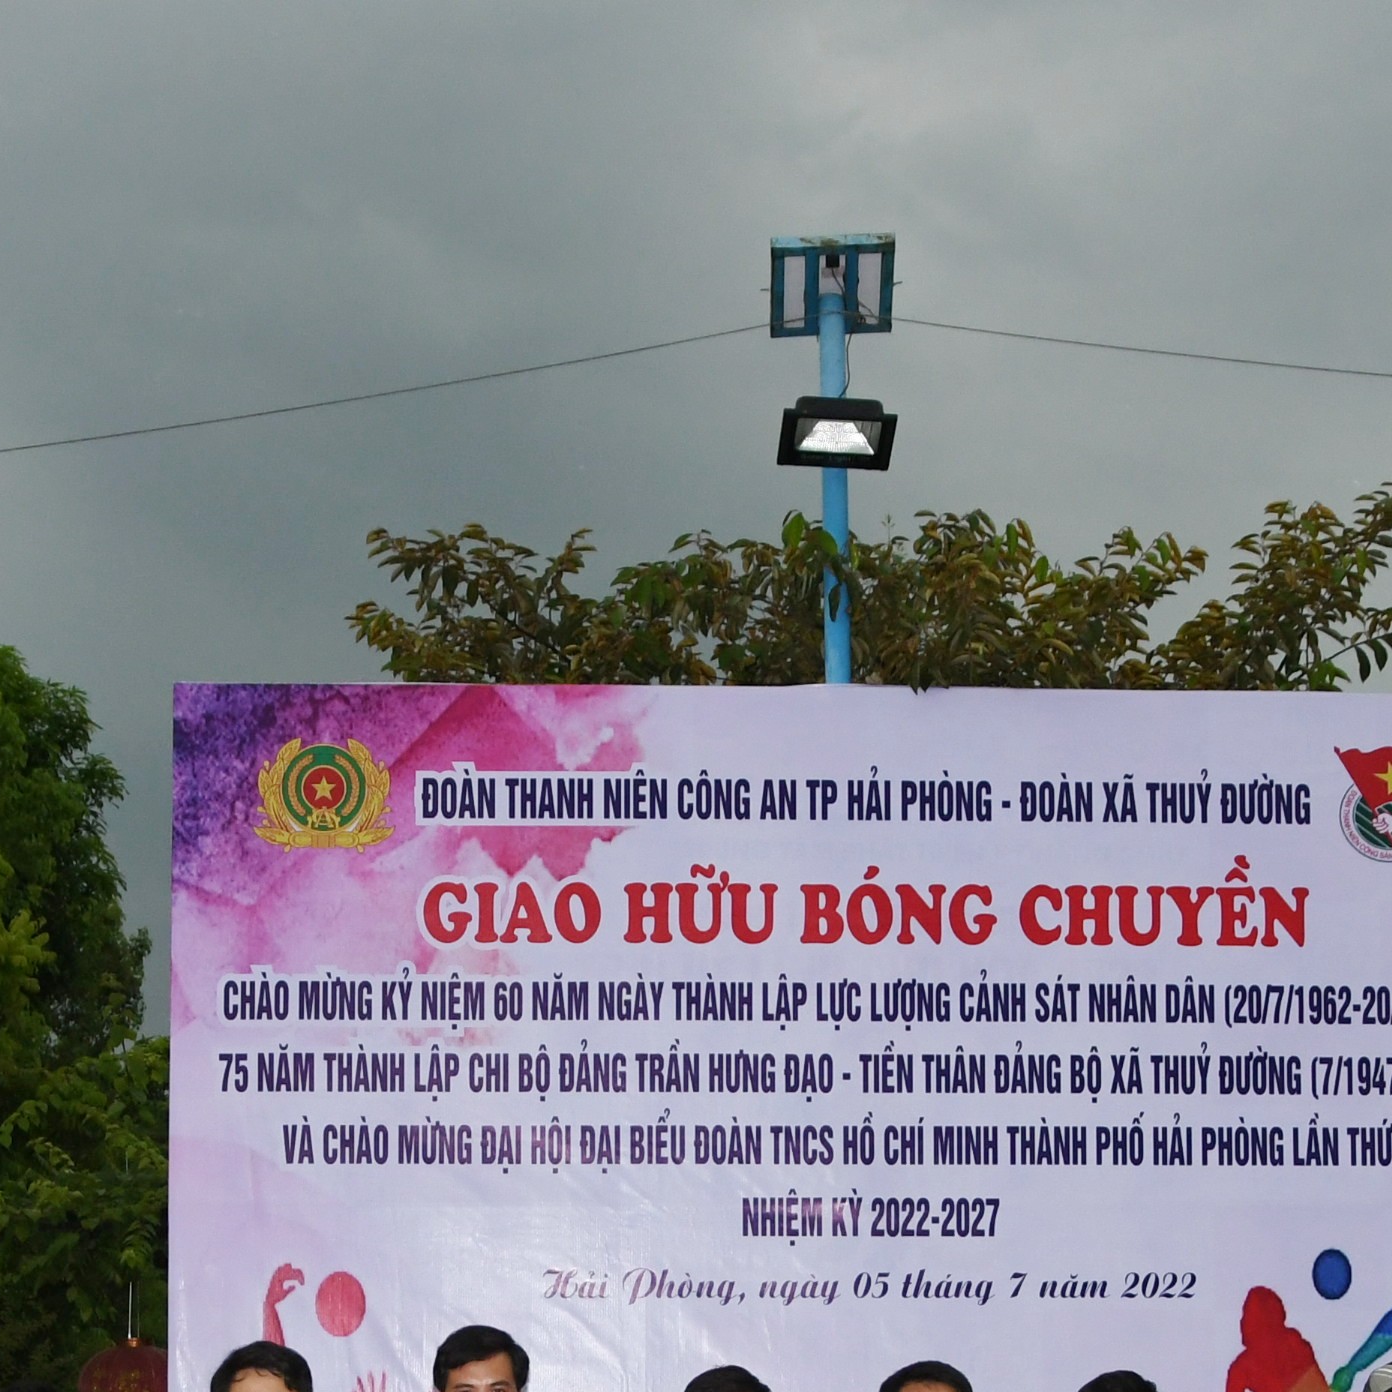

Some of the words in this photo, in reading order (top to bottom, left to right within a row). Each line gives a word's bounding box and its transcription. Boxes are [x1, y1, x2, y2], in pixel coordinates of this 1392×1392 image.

[422, 769, 495, 818] ĐOÀN
[506, 779, 593, 818] THANH
[604, 770, 667, 819] NIÊN
[678, 770, 750, 820] CÔNG
[760, 780, 796, 820] AN
[806, 780, 837, 820] TP
[848, 766, 890, 820] HẢI
[902, 771, 991, 821] PHÒNG
[1020, 773, 1092, 822] ĐOÀN
[1103, 774, 1137, 822] XÃ
[1146, 769, 1211, 823] THUỶ
[1221, 774, 1310, 824] ĐƯỜNG
[423, 882, 601, 944] GIAO
[624, 864, 778, 944] HỮU
[800, 865, 998, 945] BÓNG
[1019, 855, 1310, 947] CHUYỀN
[224, 972, 288, 1020] CHÀO
[299, 973, 372, 1020] MỪNG
[382, 968, 412, 1020] KỶ
[422, 973, 484, 1029] NIỆM
[495, 982, 522, 1020] 60
[533, 974, 588, 1020] NĂM
[599, 973, 663, 1020] NGÀY
[672, 974, 752, 1020] THÀNH
[763, 974, 807, 1030] LẬP
[817, 979, 860, 1030] LỰC
[871, 979, 950, 1031] LƯỢNG
[960, 969, 1025, 1022] CẢNH
[1036, 975, 1080, 1022] SÁT
[1089, 975, 1156, 1022] NHÂN
[1166, 976, 1214, 1023] DÂN
[219, 1054, 248, 1092] 75
[258, 1045, 314, 1091] NĂM
[324, 1045, 404, 1091] THÀNH
[415, 1045, 459, 1101] LẬP
[470, 1054, 508, 1092] CHI
[519, 1045, 549, 1101] BỘ
[559, 1040, 626, 1092] ĐẢNG
[636, 1045, 699, 1092] TRẦN
[710, 1050, 775, 1093] HƯNG
[785, 1054, 832, 1102] ĐẠO
[860, 1041, 913, 1093] TIỀN
[922, 1046, 985, 1093] THÂN
[994, 1041, 1061, 1093] ĐẢNG
[1071, 1047, 1101, 1103] BỘ
[1111, 1047, 1142, 1093] XÃ
[1151, 1042, 1210, 1094] THUỶ
[1219, 1046, 1301, 1095] ĐƯỜNG
[283, 1116, 313, 1163] VÀ
[324, 1116, 388, 1164] CHÀO
[399, 1117, 471, 1164] MỪNG
[481, 1127, 520, 1173] ĐẠI
[532, 1117, 570, 1173] HỘI
[580, 1126, 620, 1173] ĐẠI
[631, 1108, 685, 1164] BIỂU
[695, 1116, 761, 1164] ĐOÀN
[771, 1126, 833, 1165] TNCS
[844, 1117, 874, 1165] HỒ
[885, 1118, 923, 1165] CHÍ
[934, 1126, 997, 1164] MINH
[1007, 1118, 1086, 1165] THÀNH
[1096, 1112, 1143, 1165] PHỐ
[1153, 1113, 1192, 1165] HẢI
[1202, 1117, 1283, 1166] PHÒNG
[1293, 1113, 1338, 1165] LẦN
[743, 1190, 822, 1245] NHIỆM
[833, 1189, 862, 1236] KỲ
[871, 1198, 999, 1237] 2022-2027
[543, 1269, 609, 1300] Hải
[623, 1268, 746, 1306] Phòng,
[759, 1275, 840, 1306] ngày
[853, 1273, 892, 1298] 05
[902, 1269, 994, 1306] tháng
[1010, 1273, 1027, 1298] 7
[1040, 1274, 1108, 1298] năm
[1122, 1272, 1198, 1298] 2022
